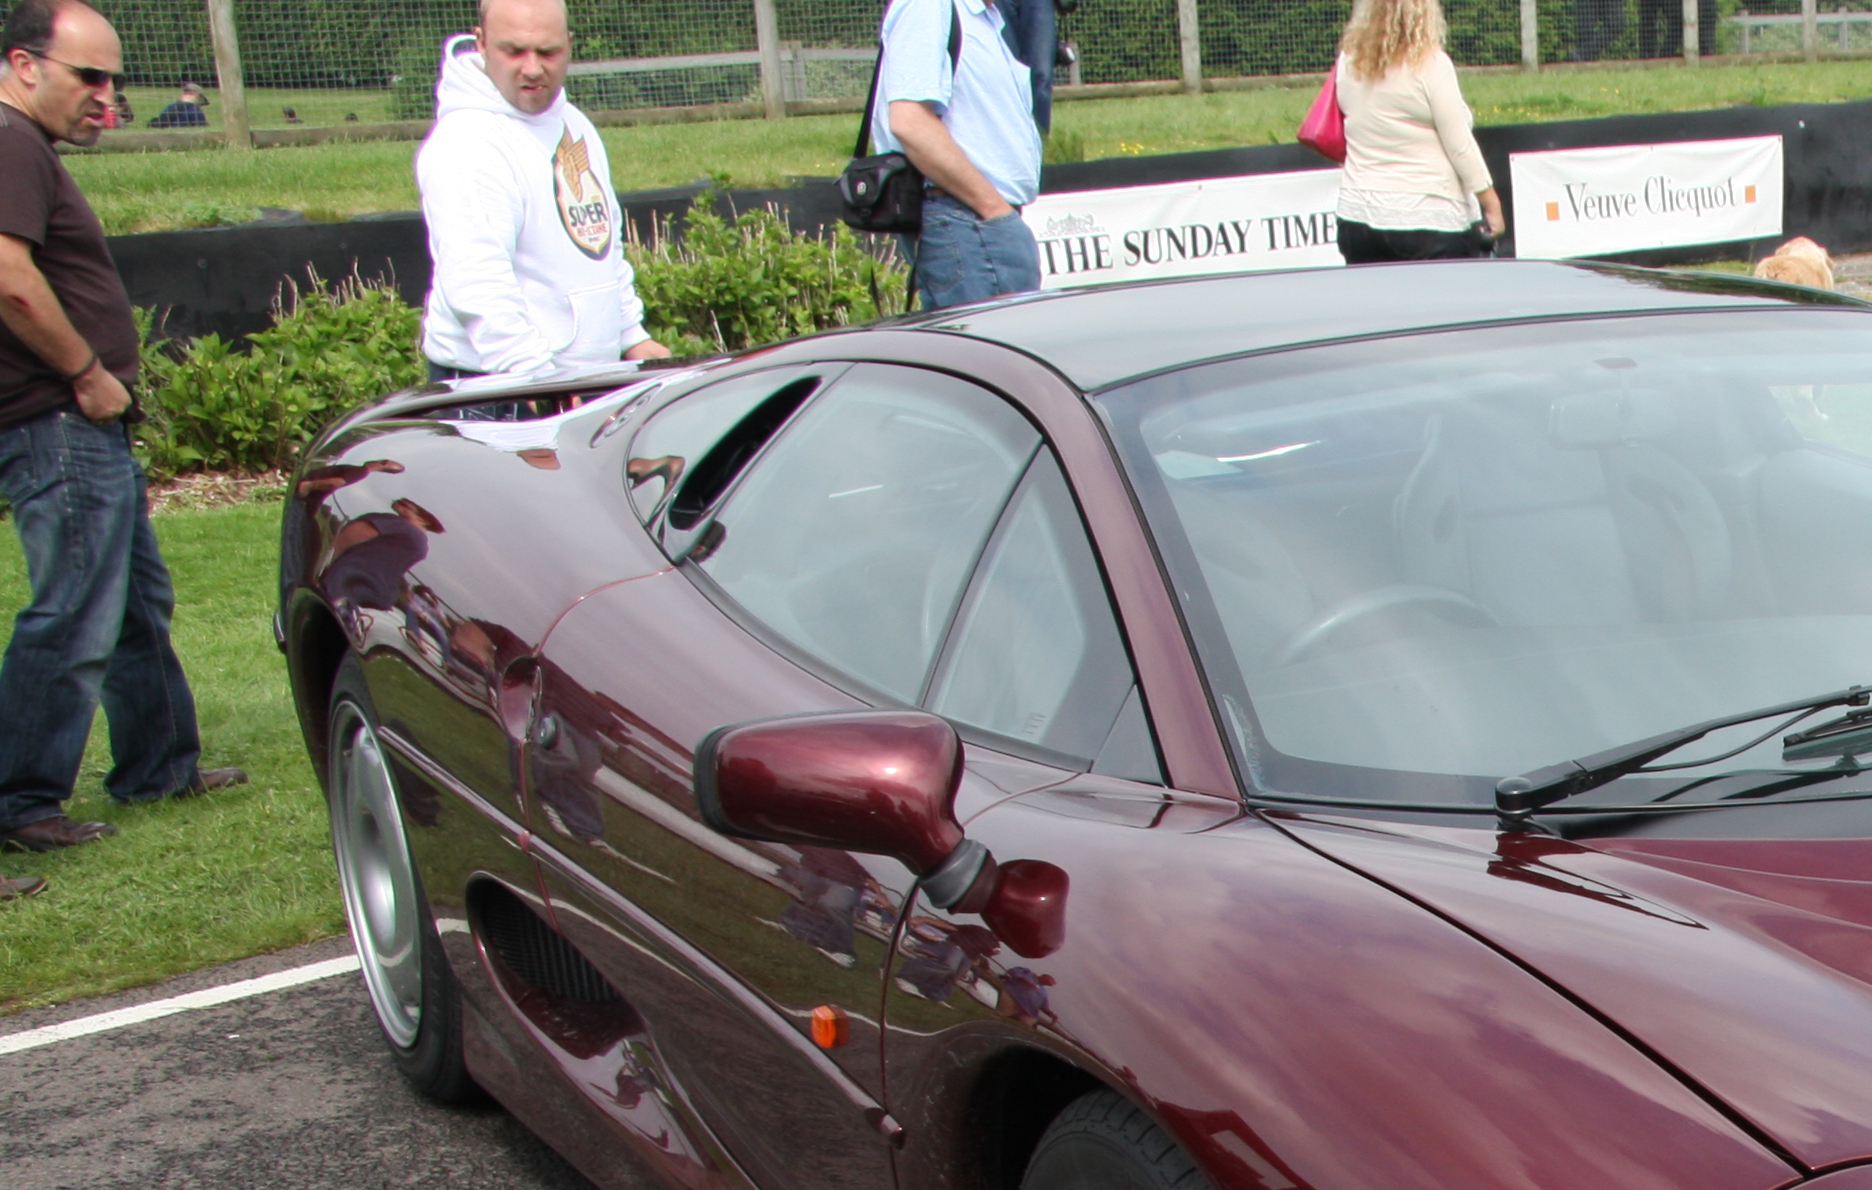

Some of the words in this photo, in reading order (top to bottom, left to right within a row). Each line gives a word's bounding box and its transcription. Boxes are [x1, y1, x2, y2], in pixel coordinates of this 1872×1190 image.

[568, 201, 609, 227] SUPER
[1563, 182, 1637, 223] Veuve
[1644, 175, 1736, 217] Clicquot
[1038, 233, 1114, 275] THE
[1122, 219, 1253, 267] SUNDAY
[1260, 211, 1339, 251] TIME
